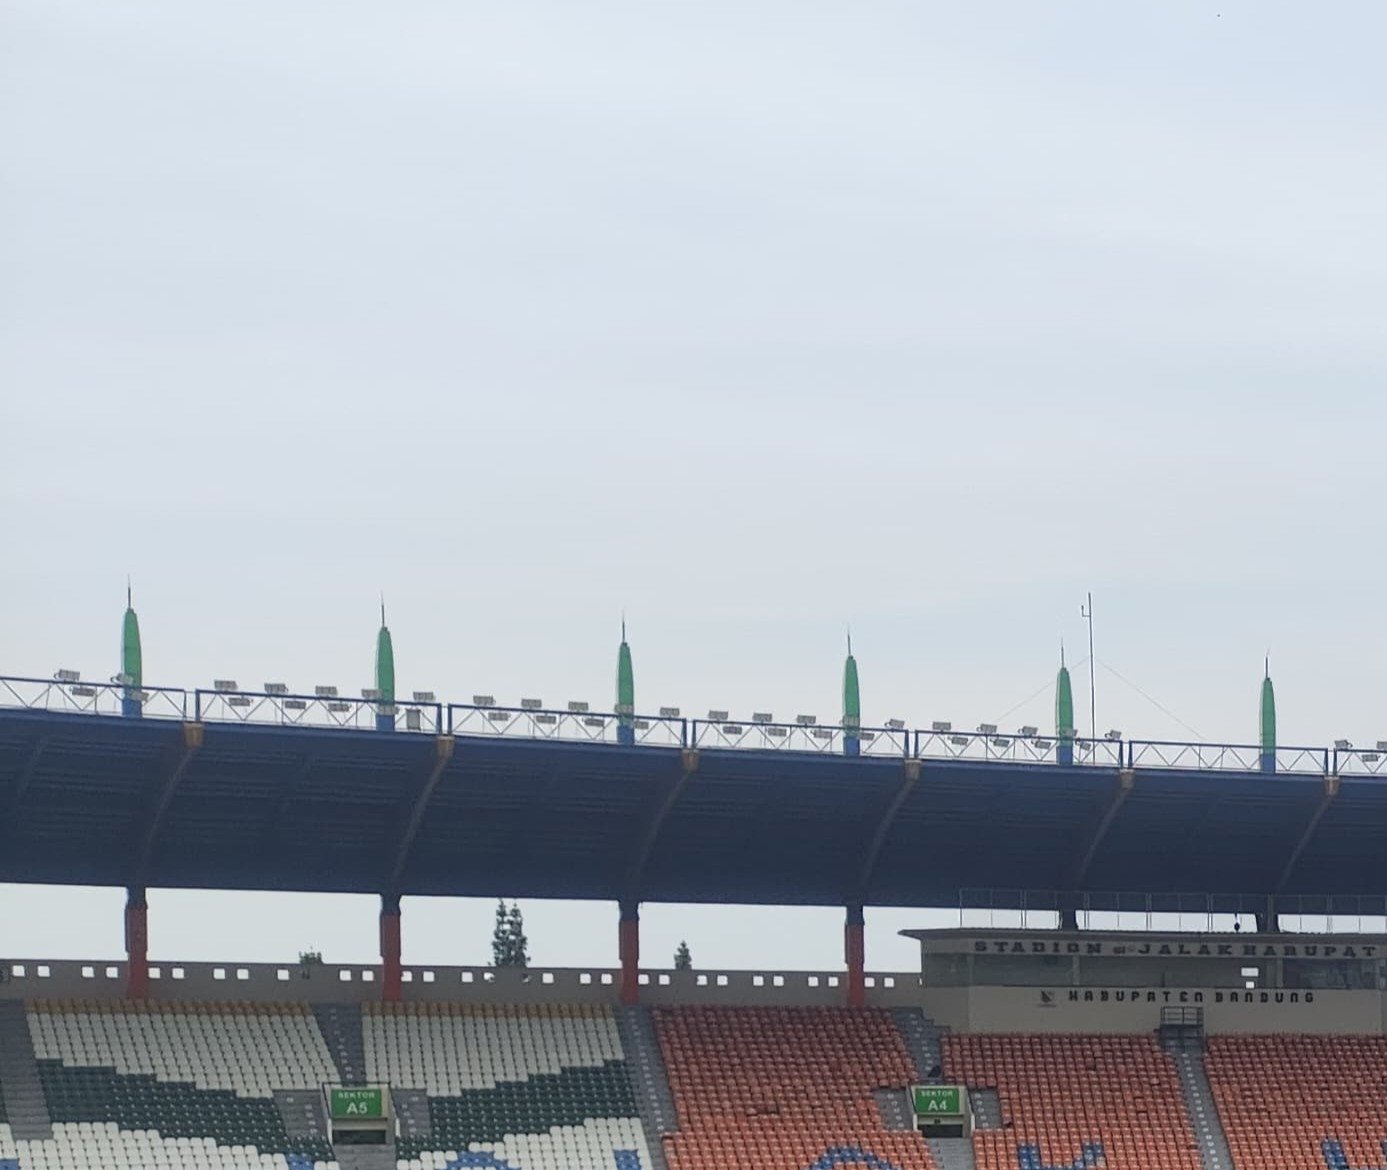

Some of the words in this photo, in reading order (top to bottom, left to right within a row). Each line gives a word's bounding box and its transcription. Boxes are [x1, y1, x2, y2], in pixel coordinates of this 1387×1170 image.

[974, 941, 1102, 955] STADION
[1138, 943, 1232, 956] JALAK
[1243, 944, 1377, 957] HARUPAT
[1069, 990, 1203, 1003] KABUPATEN
[1215, 990, 1314, 1003] BANDUNG
[347, 1102, 368, 1114] A5
[928, 1099, 948, 1111] A4
